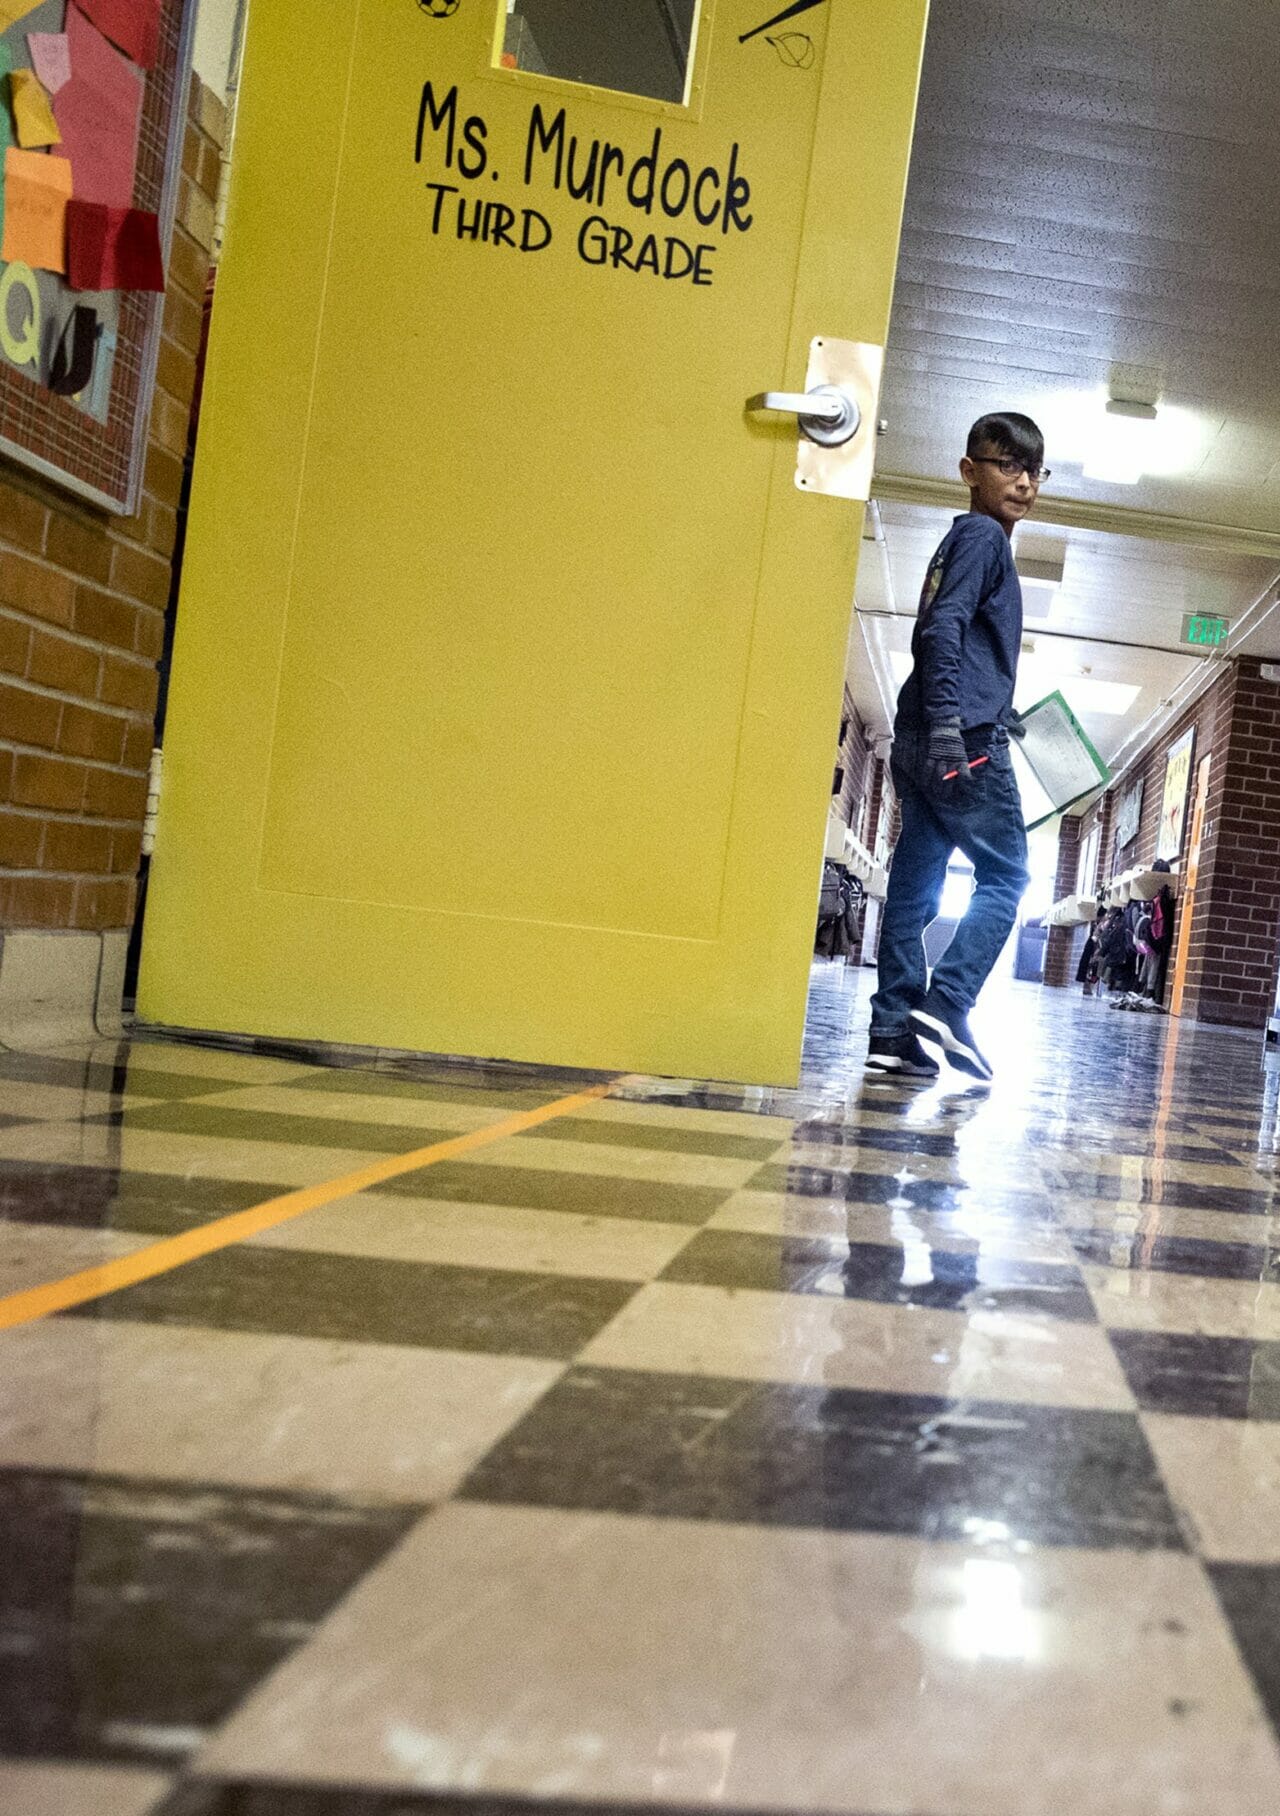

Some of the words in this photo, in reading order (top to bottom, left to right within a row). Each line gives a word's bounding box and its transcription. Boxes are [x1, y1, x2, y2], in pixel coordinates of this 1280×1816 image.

[415, 81, 499, 181] Ms.
[524, 103, 754, 234] Murdock
[426, 183, 553, 252] THIRD
[577, 216, 717, 286] GRADE
[1188, 616, 1224, 646] EXIT
